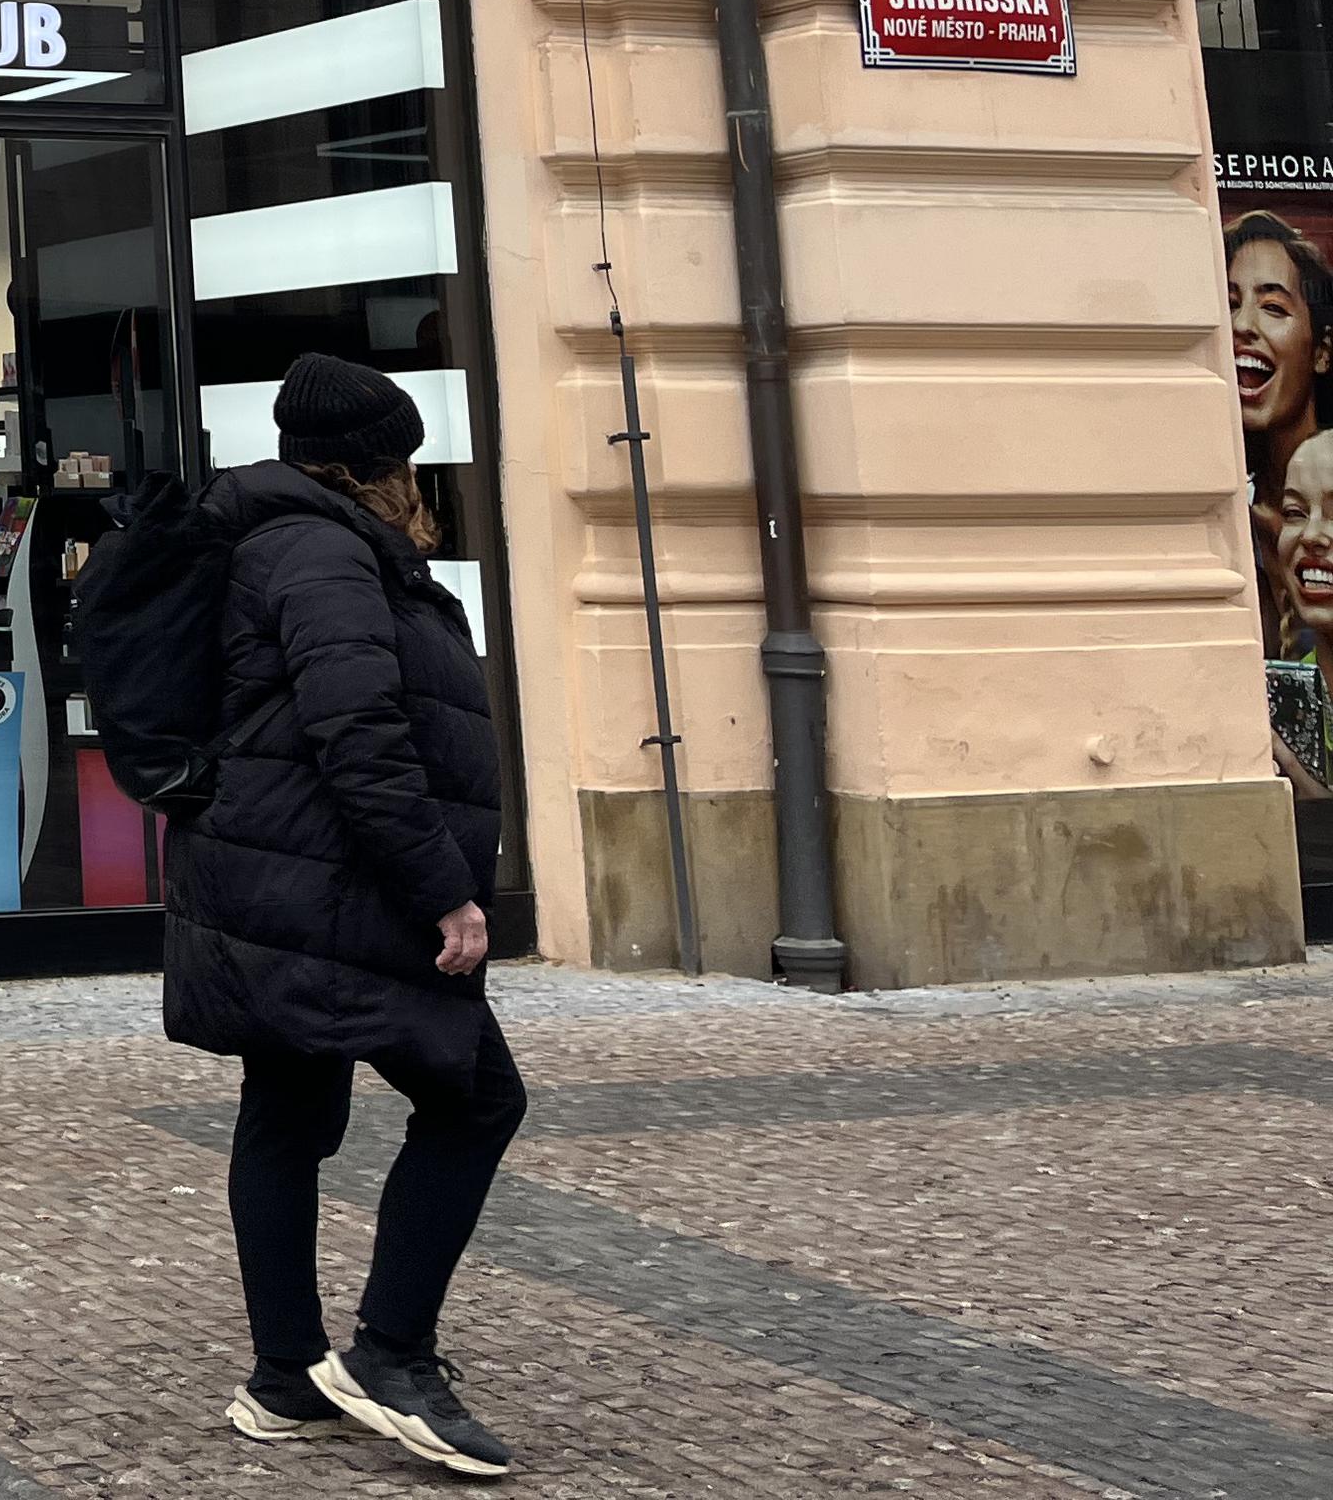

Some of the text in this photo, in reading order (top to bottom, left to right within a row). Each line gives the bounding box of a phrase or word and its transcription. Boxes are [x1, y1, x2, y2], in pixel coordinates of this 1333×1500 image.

[883, 15, 928, 38] NOVÉ
[931, 15, 985, 40] MĚSTO
[998, 22, 1046, 43] PRAHA
[1049, 25, 1058, 43] 1
[1213, 153, 1333, 178] SEPHORA
